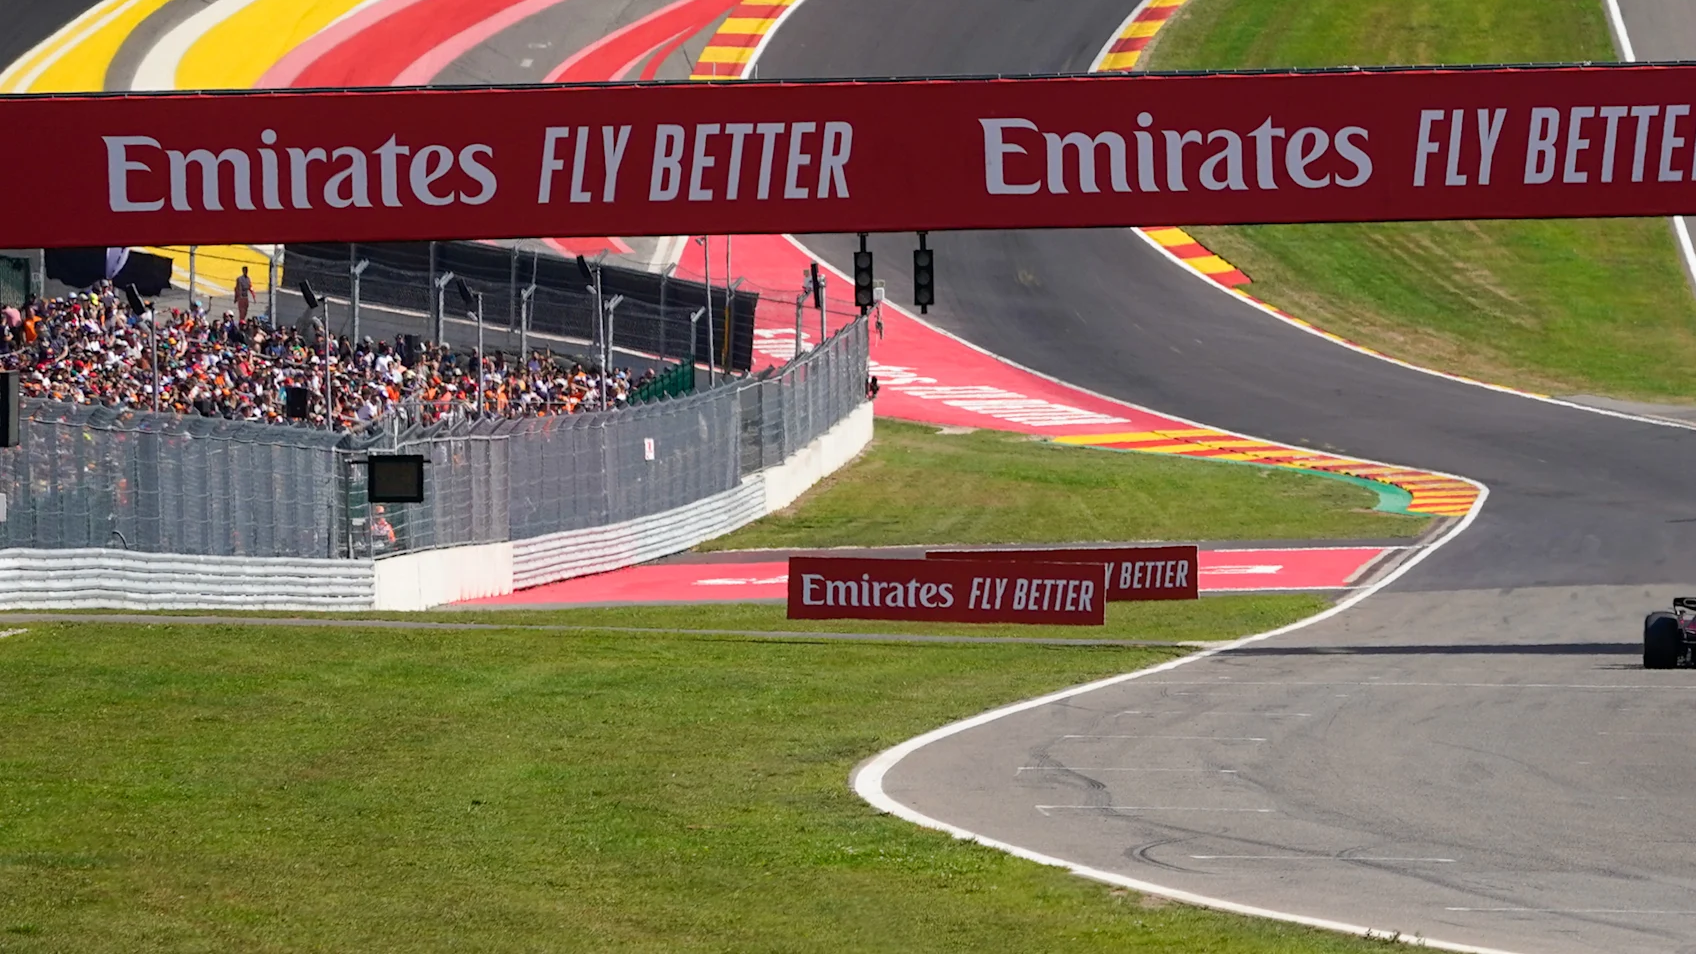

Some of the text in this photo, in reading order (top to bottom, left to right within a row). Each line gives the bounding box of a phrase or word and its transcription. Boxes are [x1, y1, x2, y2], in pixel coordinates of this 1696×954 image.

[101, 129, 498, 213] Emirates
[539, 125, 630, 204] FLY
[650, 121, 853, 201] BETTER
[979, 112, 1373, 195] Emirates
[1413, 108, 1506, 187] FLY
[801, 573, 953, 608] Emirates
[968, 578, 1008, 610] FLY
[1012, 578, 1094, 612] BETTER
[1119, 560, 1189, 589] BETTER
